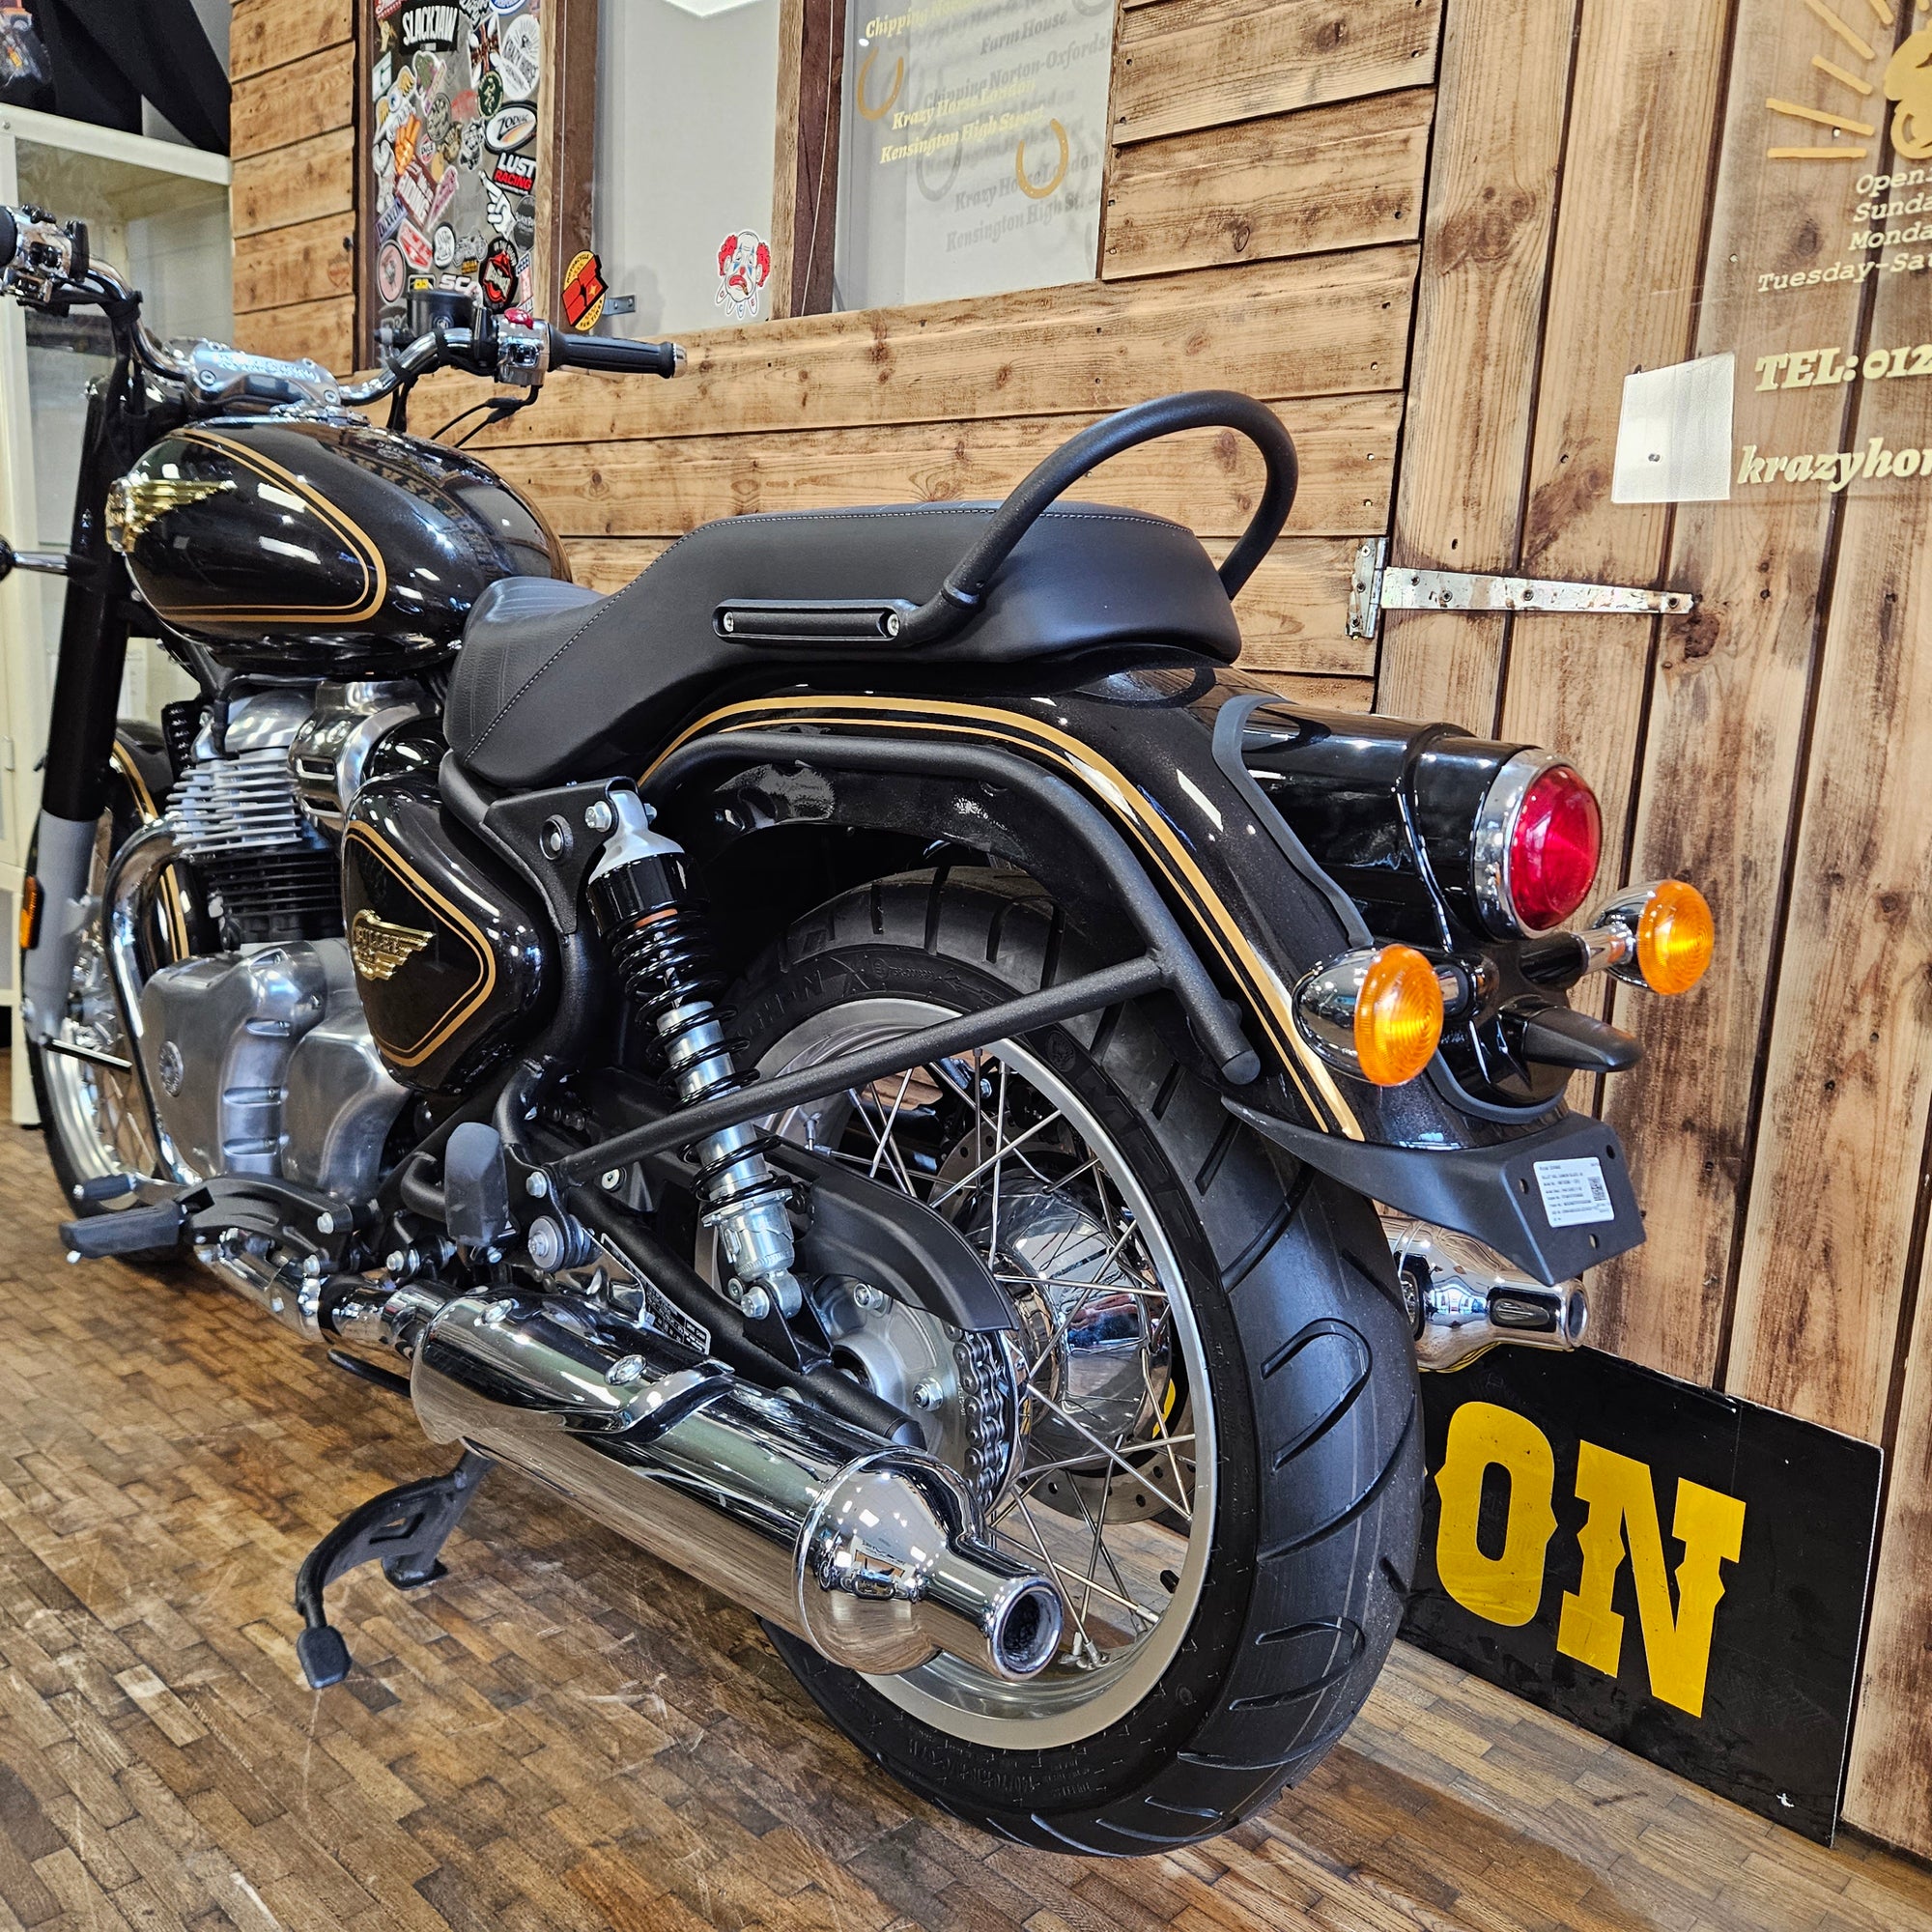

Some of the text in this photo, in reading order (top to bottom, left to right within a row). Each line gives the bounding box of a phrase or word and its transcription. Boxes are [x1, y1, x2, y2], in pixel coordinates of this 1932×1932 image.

[402, 5, 458, 46] SLACKJAW
[892, 107, 935, 130] Krazy
[879, 130, 959, 164] Kensington
[961, 114, 998, 144] High
[494, 169, 532, 190] RACING
[497, 152, 537, 179] LUST
[999, 169, 1040, 198] Hose
[1848, 221, 1932, 251] Monda
